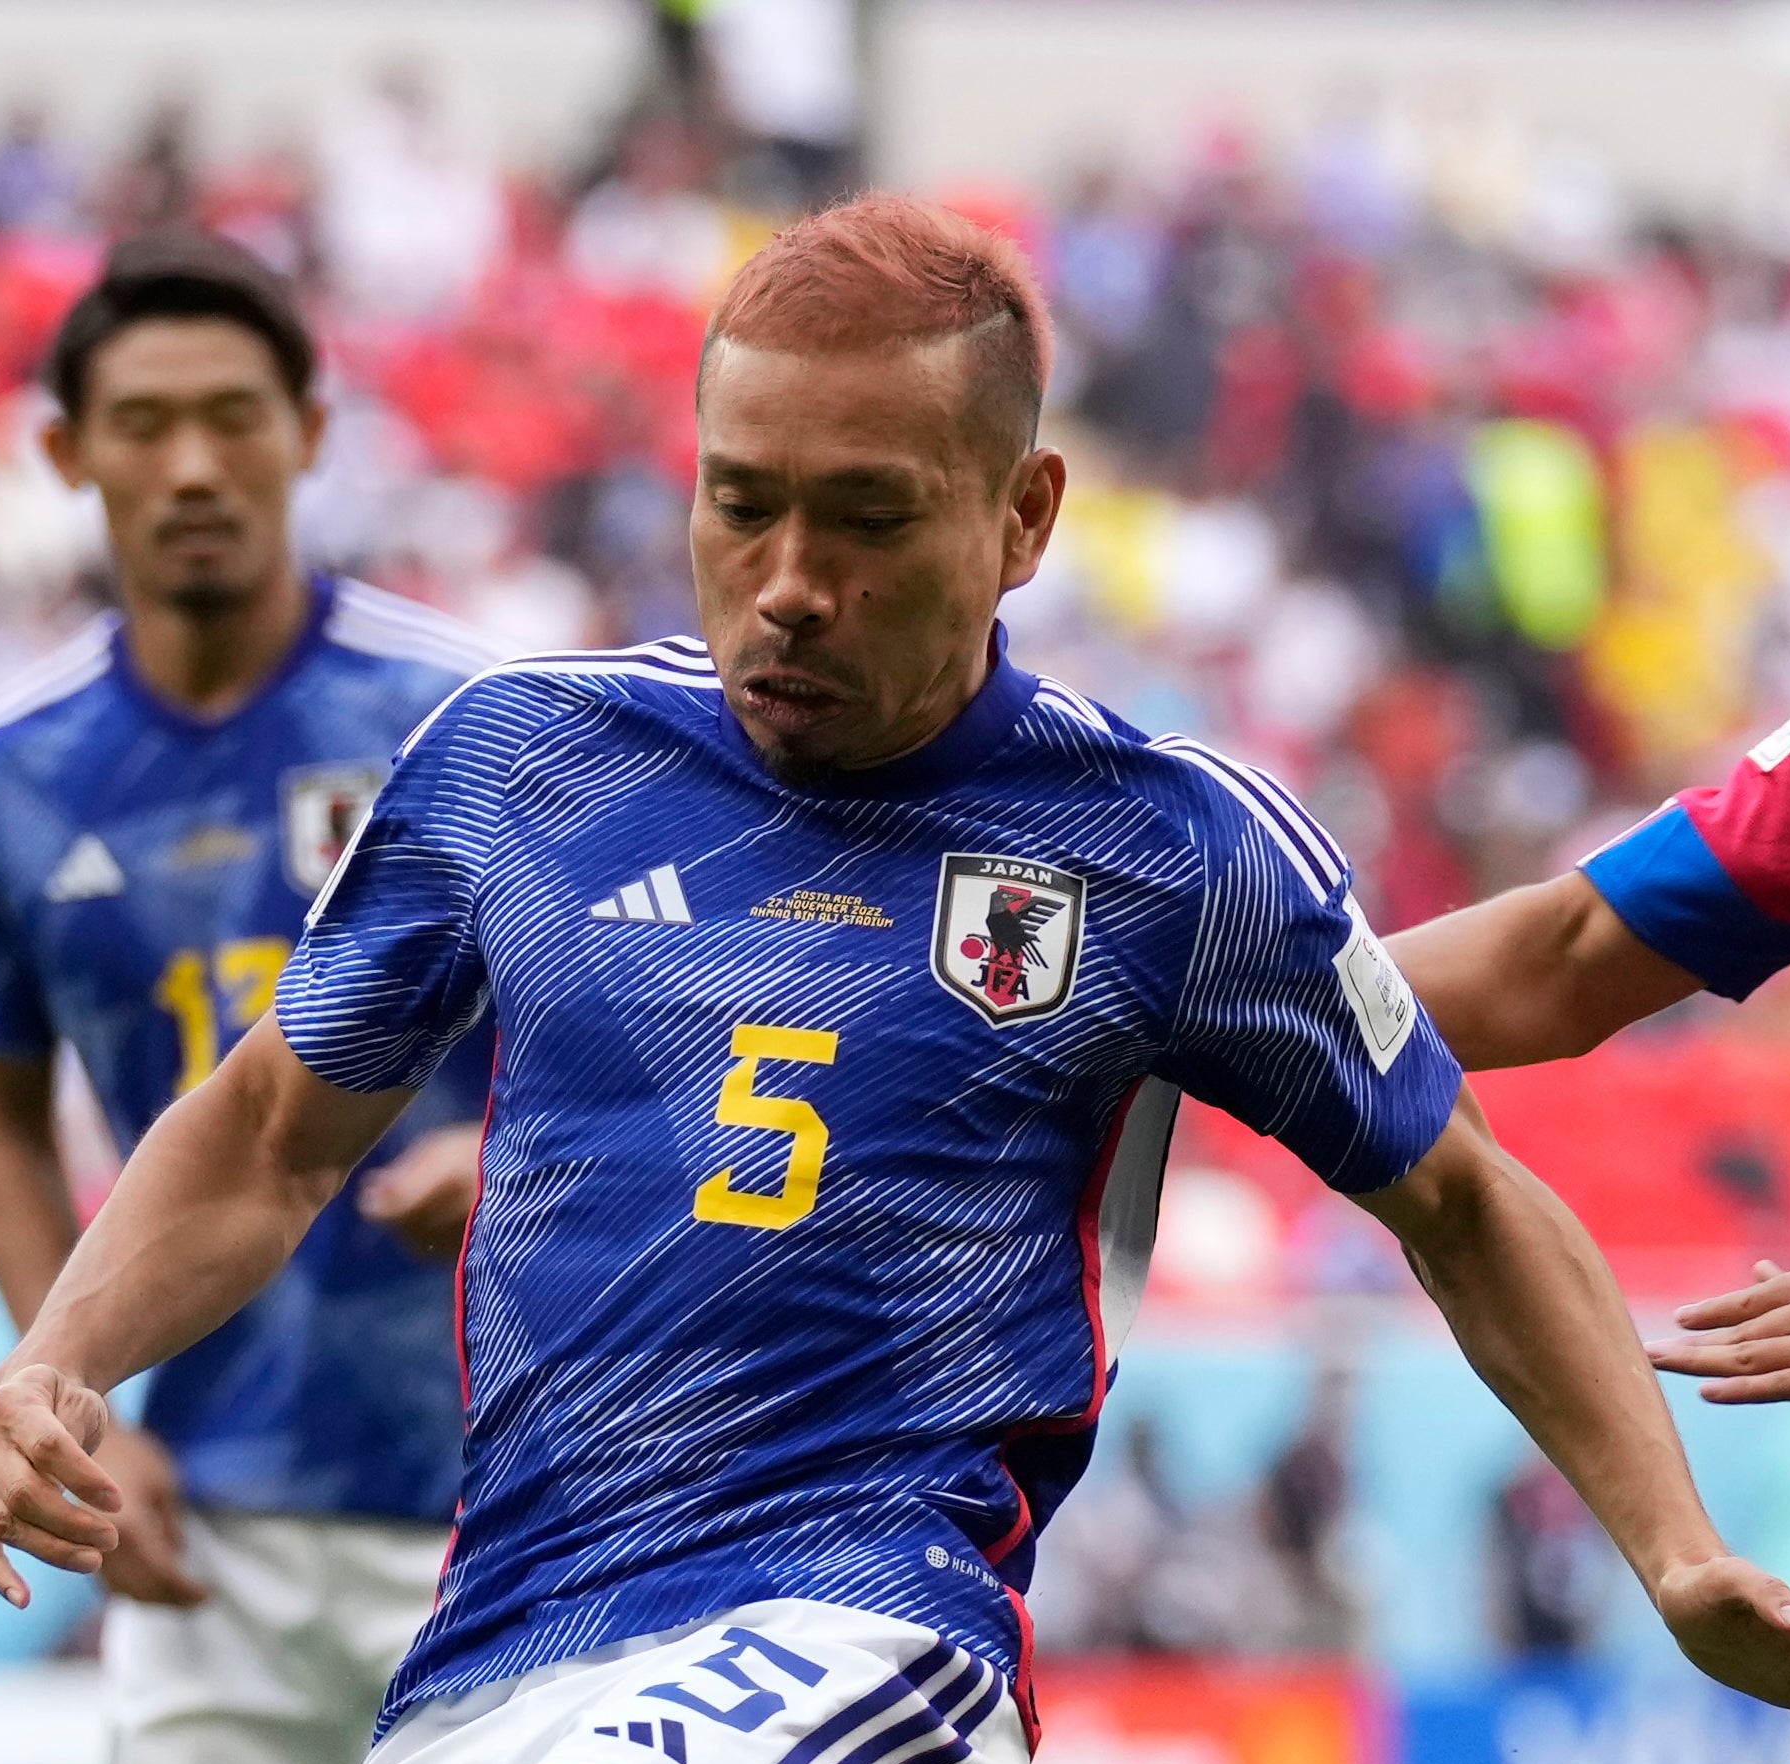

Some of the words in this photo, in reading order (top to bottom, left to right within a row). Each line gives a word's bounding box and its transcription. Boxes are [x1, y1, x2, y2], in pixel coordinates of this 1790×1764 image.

[979, 861, 1053, 884] JAPAN
[766, 897, 783, 909] 27
[784, 899, 848, 913] NOVEMBER
[851, 905, 883, 917] 2022
[792, 889, 831, 902] COSTA
[832, 894, 863, 905] RICA
[749, 906, 791, 919] AHMAD
[793, 911, 815, 922] BIN
[817, 914, 839, 924] ALI
[842, 915, 894, 928] STADIUM
[970, 964, 1031, 1001] JFA
[692, 1023, 840, 1231] 5
[951, 1556, 999, 1592] HEAT.RDY
[637, 1627, 828, 1733] 5
